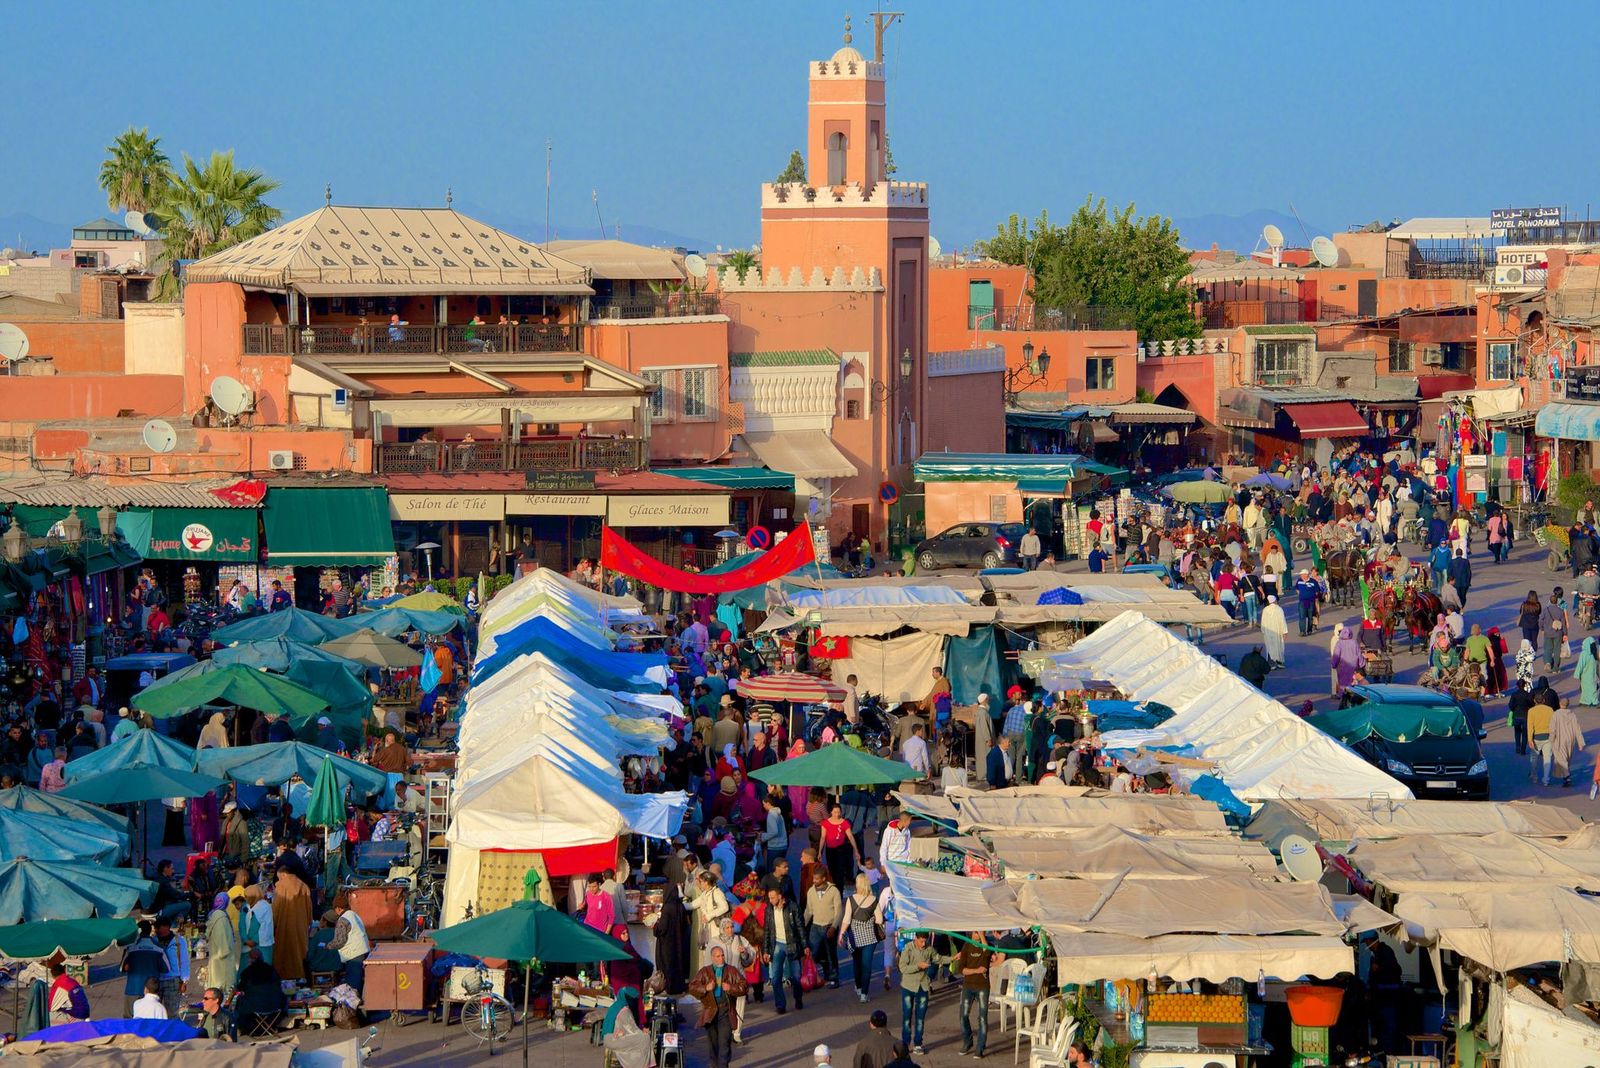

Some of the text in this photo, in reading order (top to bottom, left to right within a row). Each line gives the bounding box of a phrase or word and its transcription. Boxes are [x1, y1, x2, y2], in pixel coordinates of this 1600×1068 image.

[1492, 208, 1559, 219] فندق بنوراما
[1491, 219, 1560, 228] HOTEL PANORAMA
[1501, 253, 1538, 264] HOTEL
[406, 497, 487, 510] Salon de Thé
[524, 495, 591, 505] Restaurant
[629, 504, 709, 518] Glaces Maison
[399, 972, 411, 989] 2
